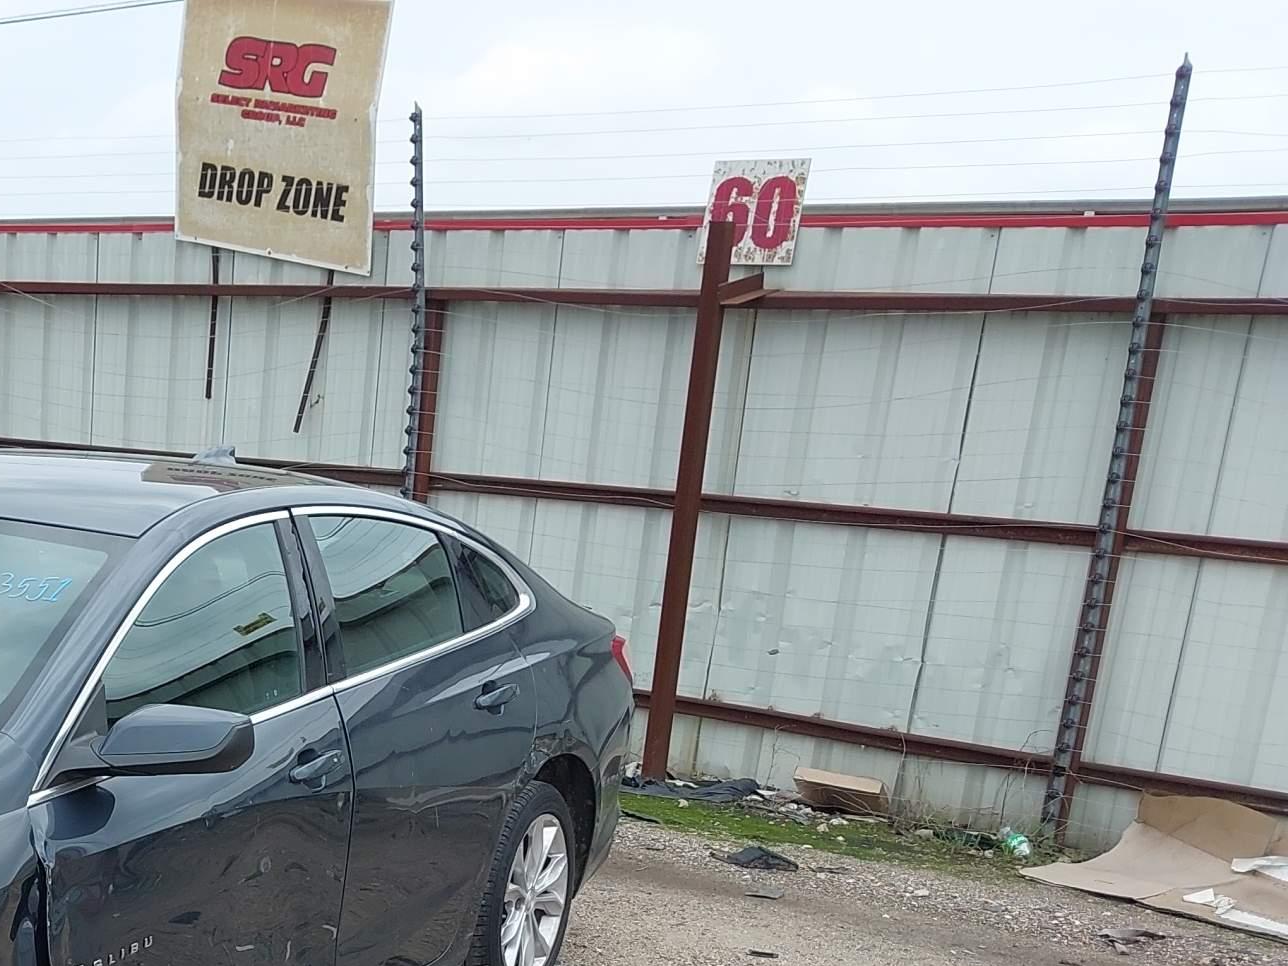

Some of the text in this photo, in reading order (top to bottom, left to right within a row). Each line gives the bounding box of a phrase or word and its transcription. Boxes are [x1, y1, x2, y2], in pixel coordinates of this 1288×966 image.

[218, 36, 337, 98] SRG
[198, 162, 350, 222] DROP ZONE
[711, 176, 797, 250] 60
